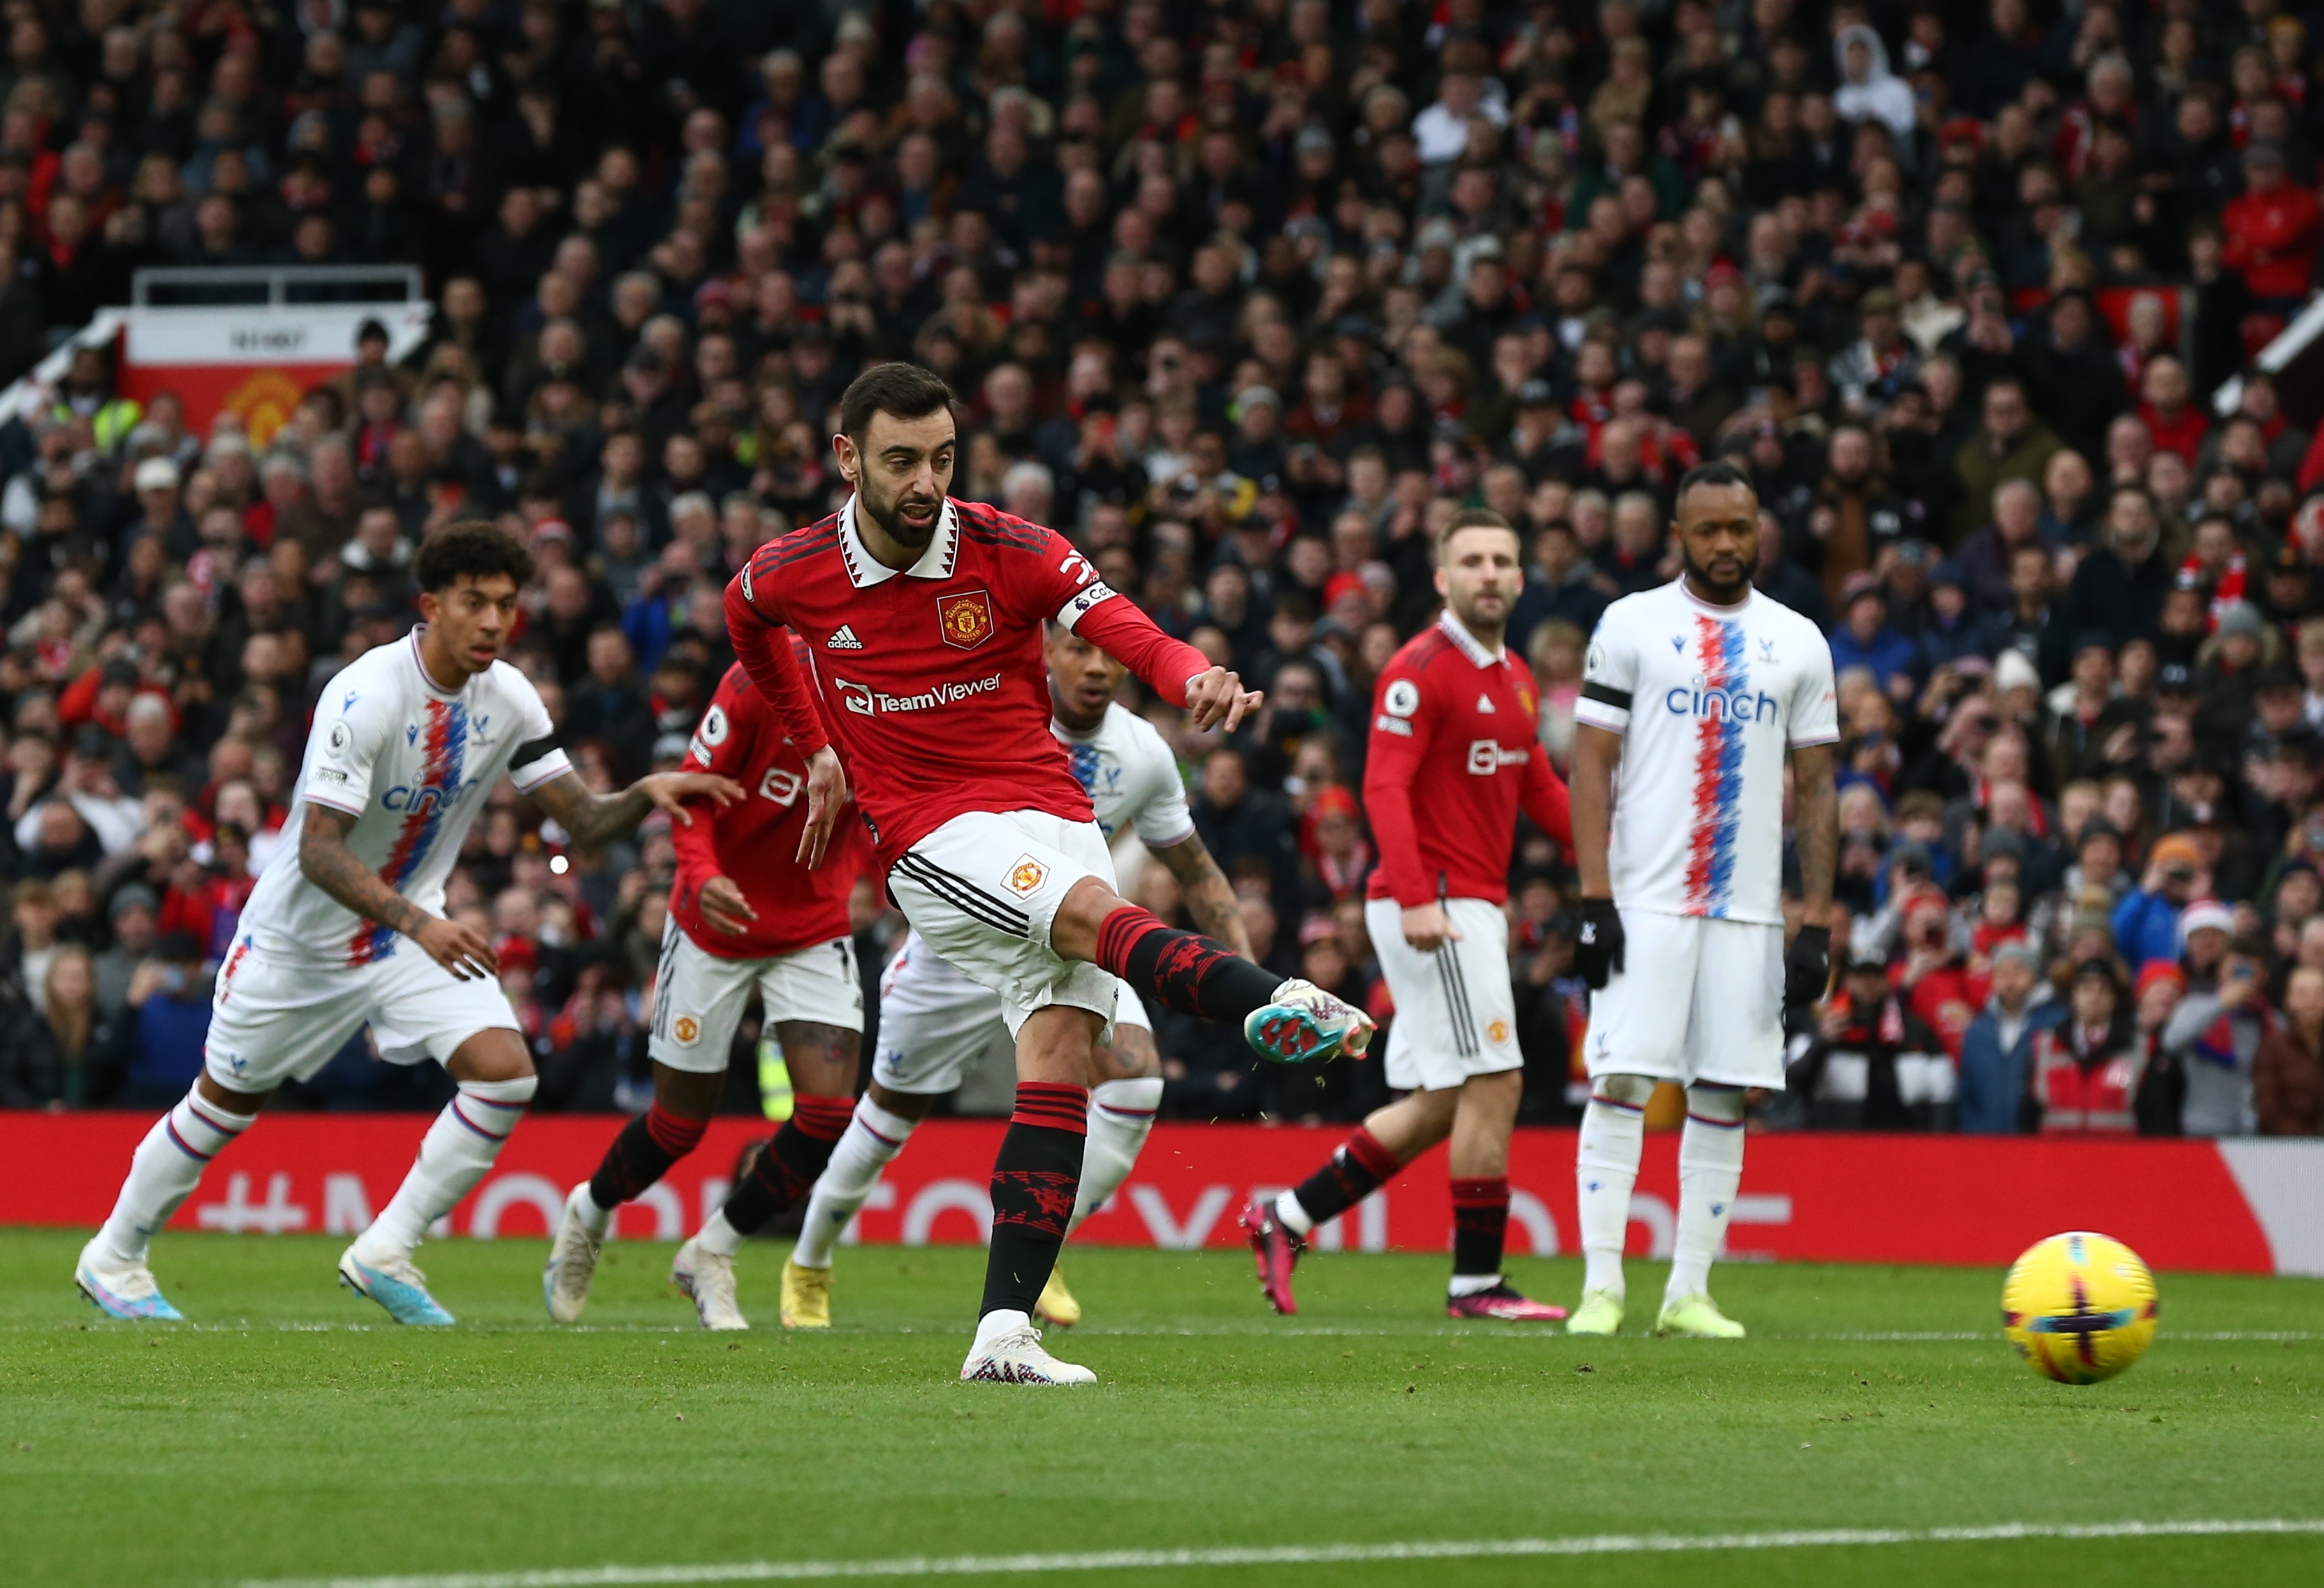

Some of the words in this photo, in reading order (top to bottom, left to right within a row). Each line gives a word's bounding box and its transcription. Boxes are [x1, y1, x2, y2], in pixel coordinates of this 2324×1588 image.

[949, 602, 981, 618] MANCHESTER
[957, 629, 981, 639] UNITED
[827, 640, 863, 649] adidas
[874, 673, 1001, 713] TeamViewer
[1667, 674, 1778, 726] cinch
